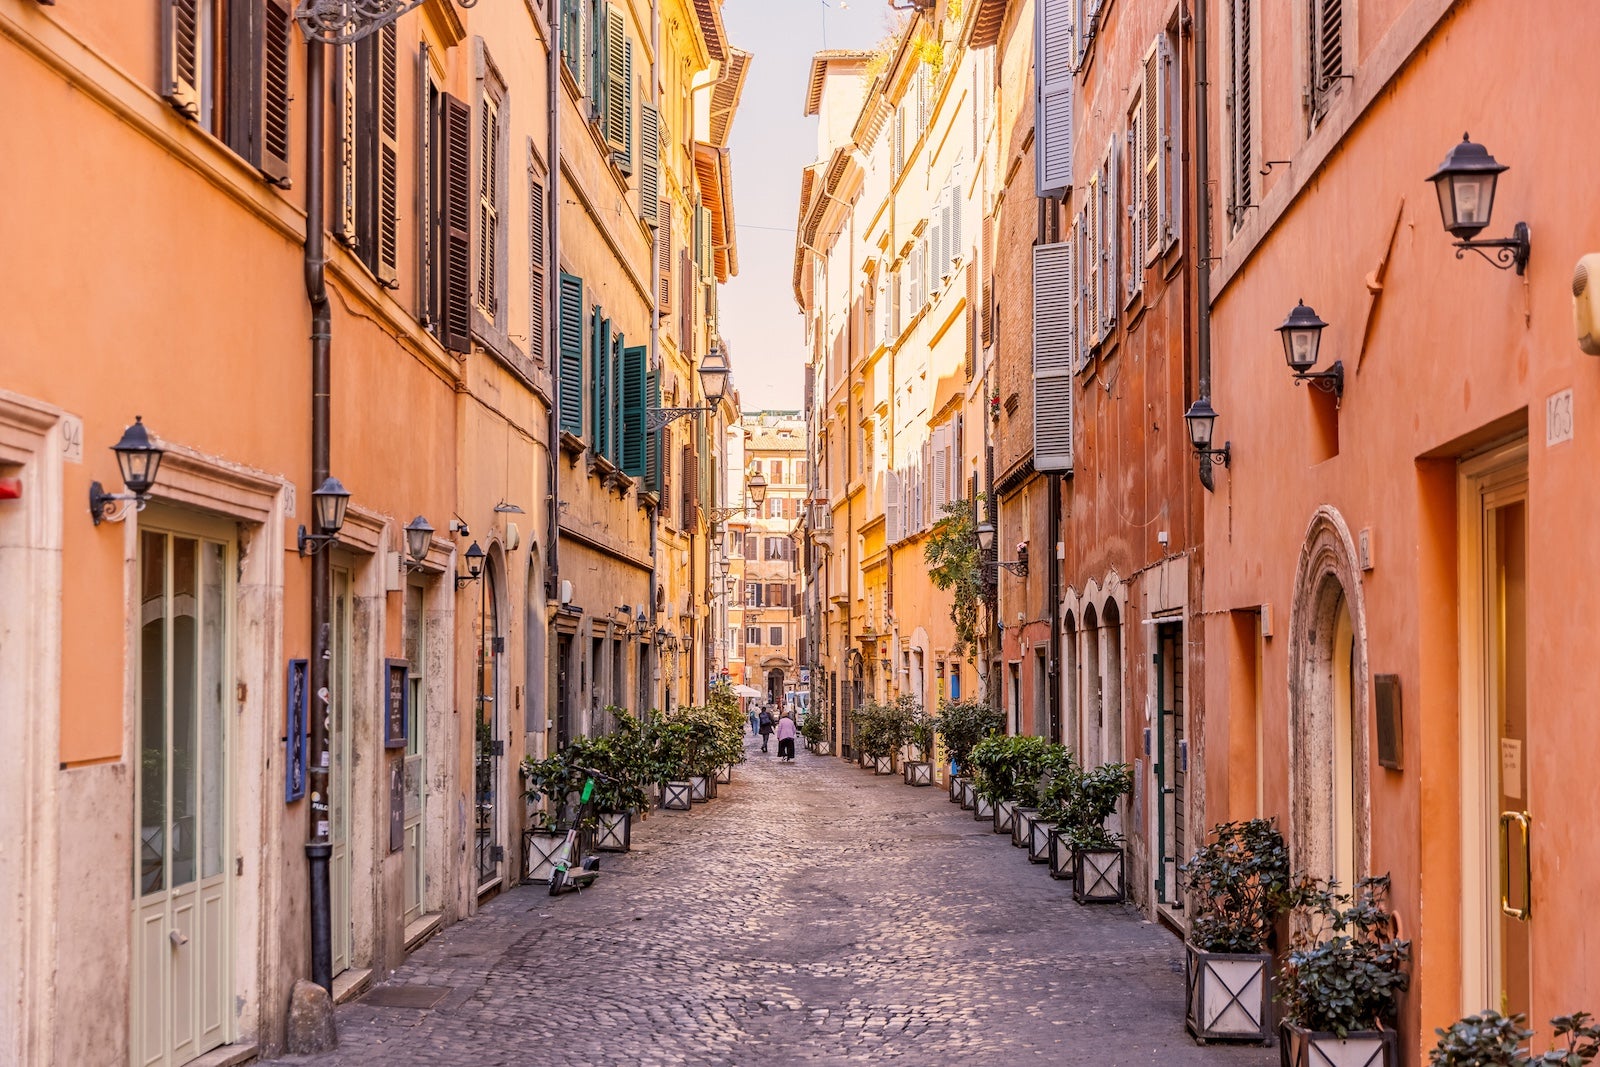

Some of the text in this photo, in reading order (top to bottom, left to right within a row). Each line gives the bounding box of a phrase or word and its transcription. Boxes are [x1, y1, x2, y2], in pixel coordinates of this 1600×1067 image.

[1548, 394, 1572, 441] 163
[63, 420, 81, 456] 94
[284, 486, 295, 513] 95
